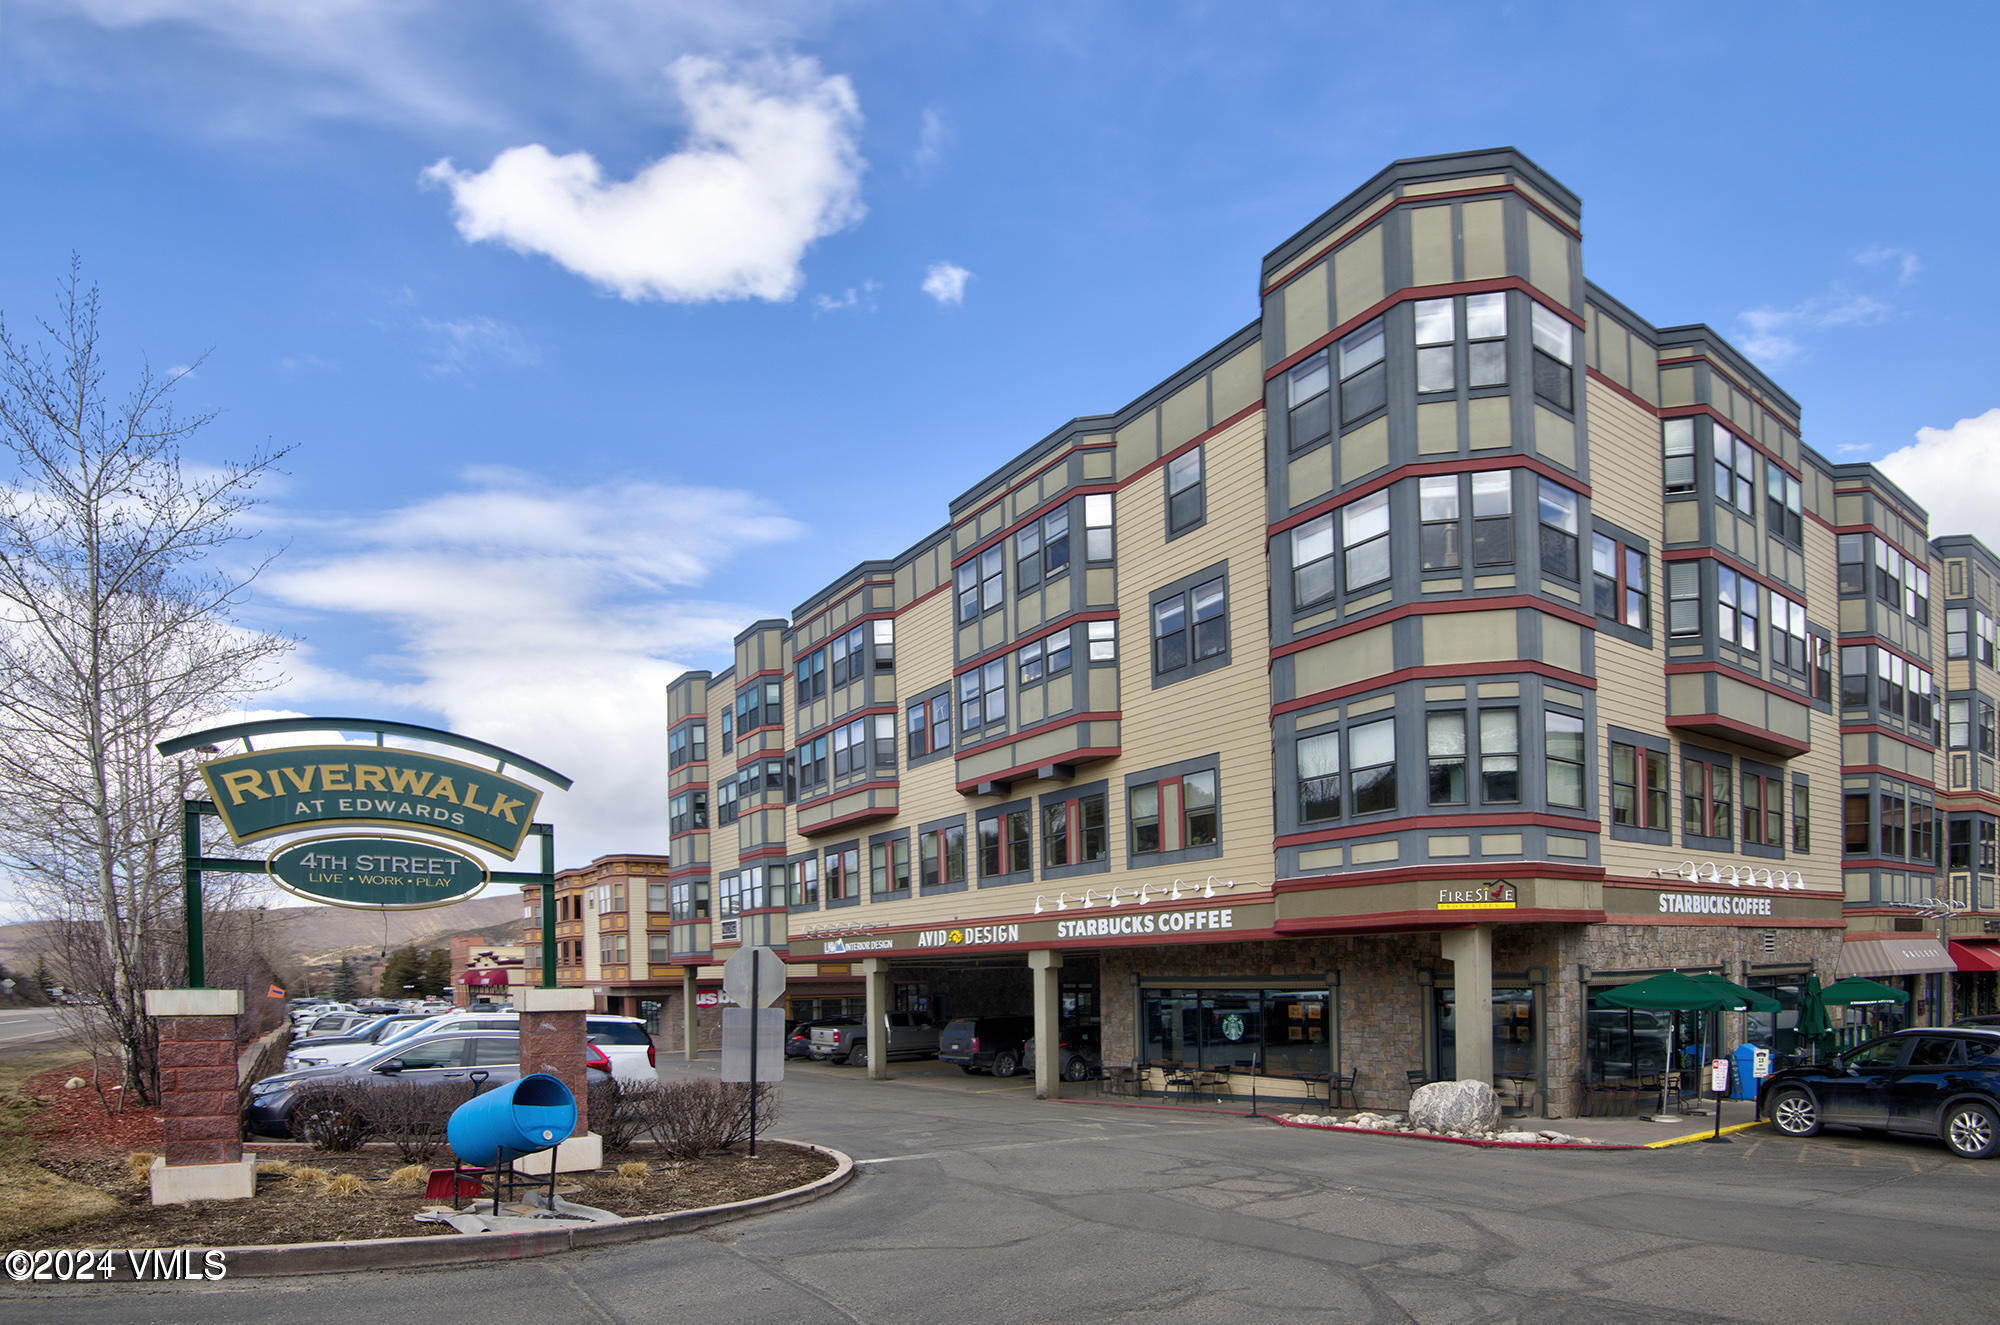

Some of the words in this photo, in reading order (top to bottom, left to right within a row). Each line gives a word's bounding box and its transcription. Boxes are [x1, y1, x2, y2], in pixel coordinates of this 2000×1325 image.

[220, 763, 526, 825] RIVERWALK
[295, 800, 325, 816] AT
[339, 799, 465, 825] EDWARDS
[300, 852, 348, 871] 4TH
[355, 854, 461, 875] STREET
[309, 873, 344, 883] LIVE
[358, 874, 404, 885] WORK
[416, 877, 452, 887] PLAY
[1658, 893, 1731, 914] STARBUCKS
[1732, 897, 1771, 915] COFFEE
[1057, 914, 1155, 938] STARBUCKS
[1158, 909, 1233, 932] COFFEE
[871, 940, 893, 950] DESIGN
[918, 930, 947, 947] AVID
[965, 924, 1019, 945] DESIGN
